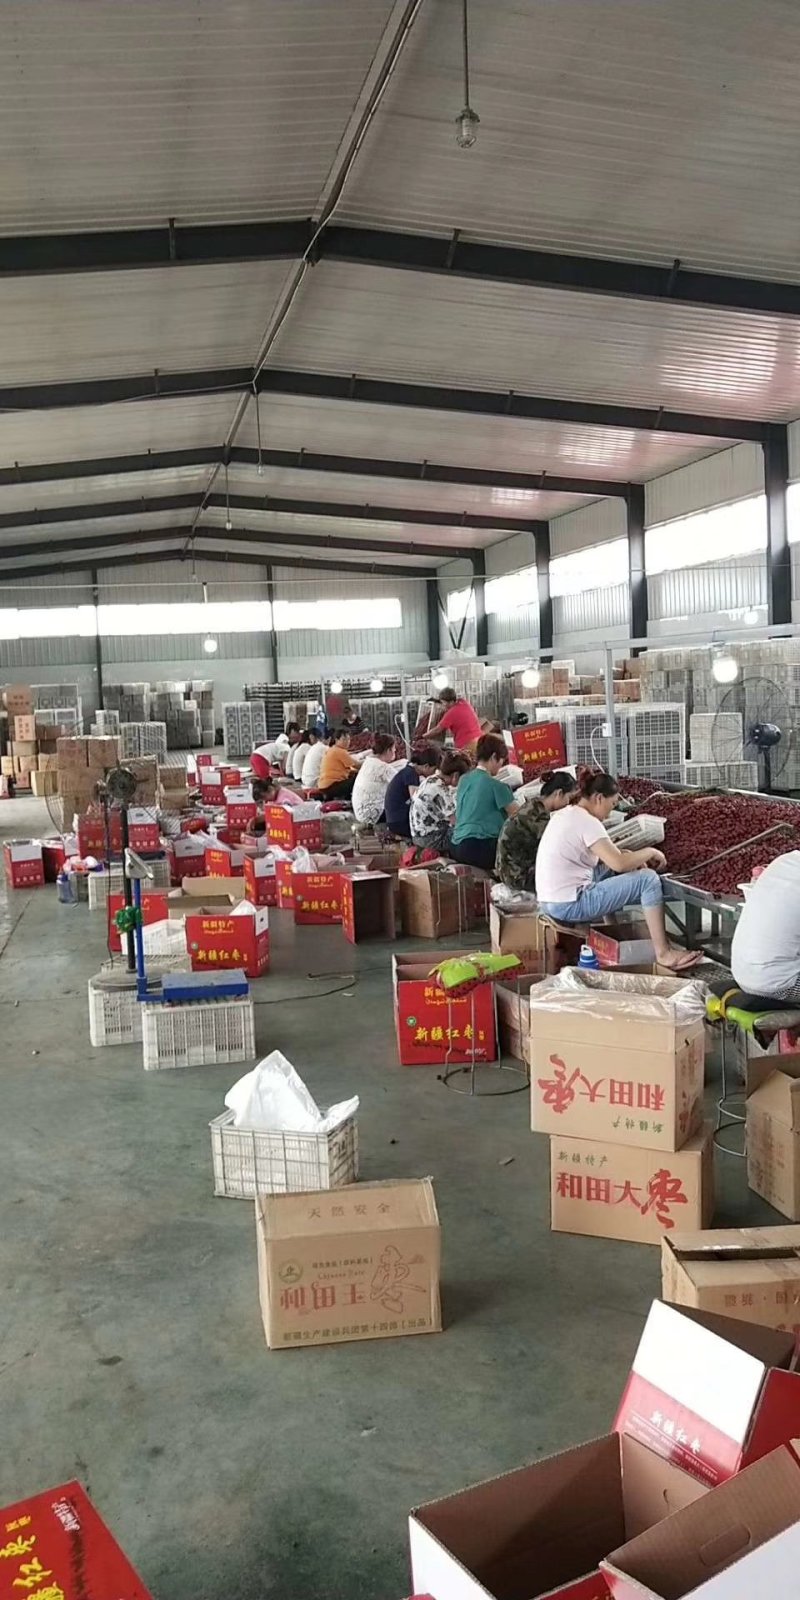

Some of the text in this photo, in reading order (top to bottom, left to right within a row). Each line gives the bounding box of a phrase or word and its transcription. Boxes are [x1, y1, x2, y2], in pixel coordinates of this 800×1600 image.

[537, 1053, 666, 1114] 和田大枣
[558, 1151, 608, 1168] 新疆特产
[556, 1168, 688, 1229] 和田大枣
